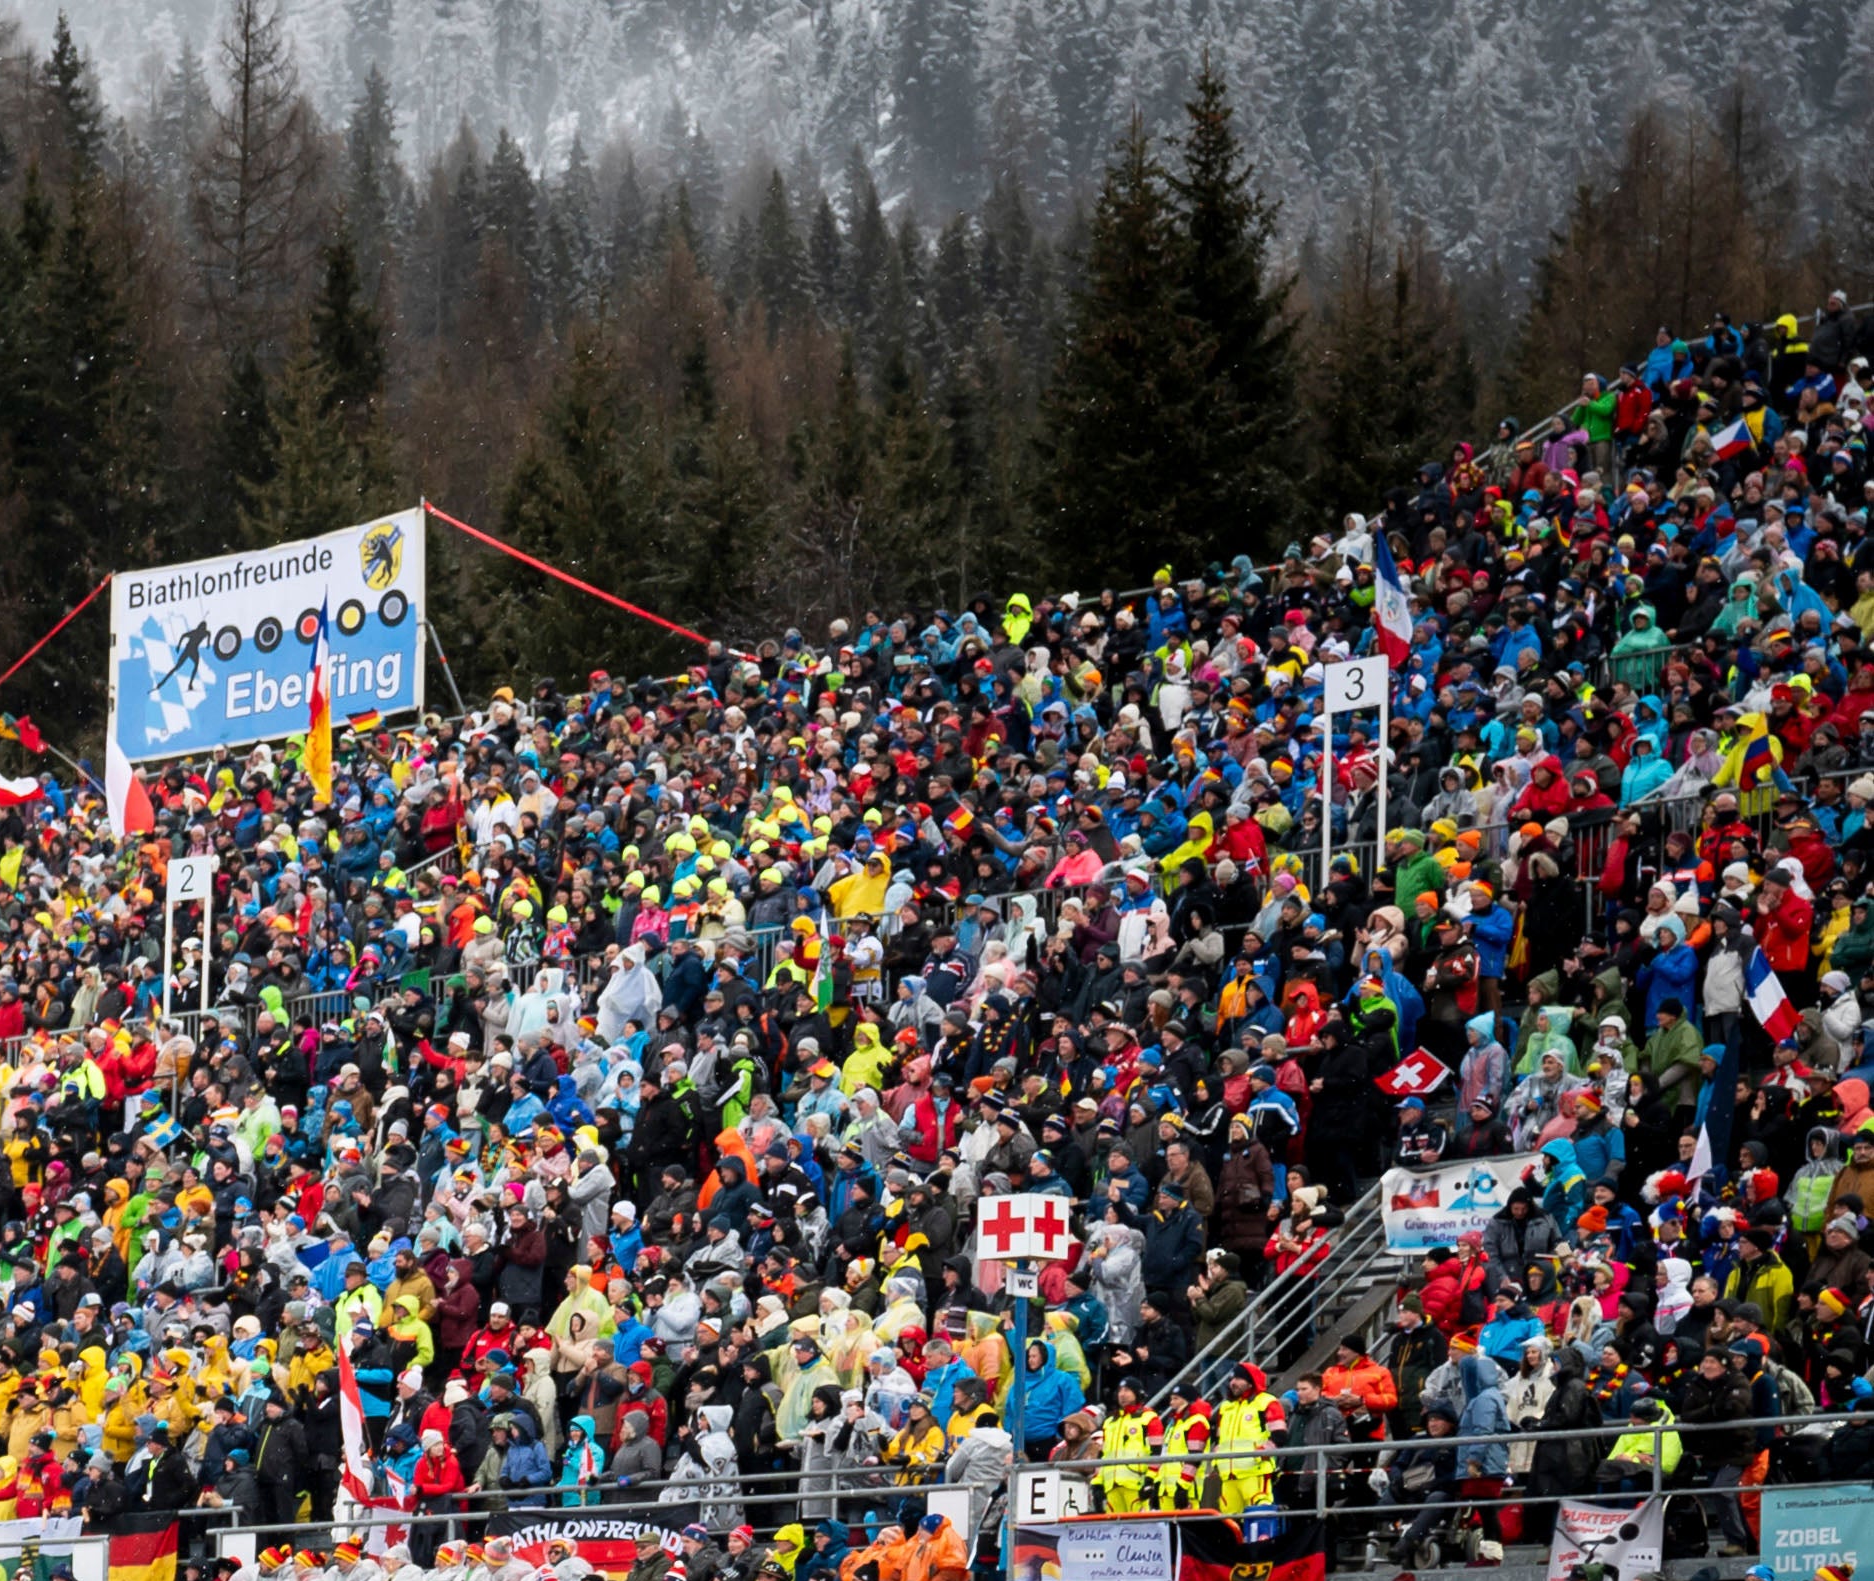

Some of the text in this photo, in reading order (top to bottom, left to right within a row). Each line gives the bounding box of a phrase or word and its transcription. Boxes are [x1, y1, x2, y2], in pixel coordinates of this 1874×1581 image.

[128, 545, 334, 609] Biathlonfreunde
[1344, 666, 1365, 701] 3
[180, 864, 195, 893] 2
[1471, 1215, 1492, 1227] Cro
[1018, 1279, 1033, 1290] WC
[1030, 1477, 1047, 1515] E
[1775, 1527, 1842, 1548] ZOBEL
[1775, 1551, 1858, 1574] ULTRAS
